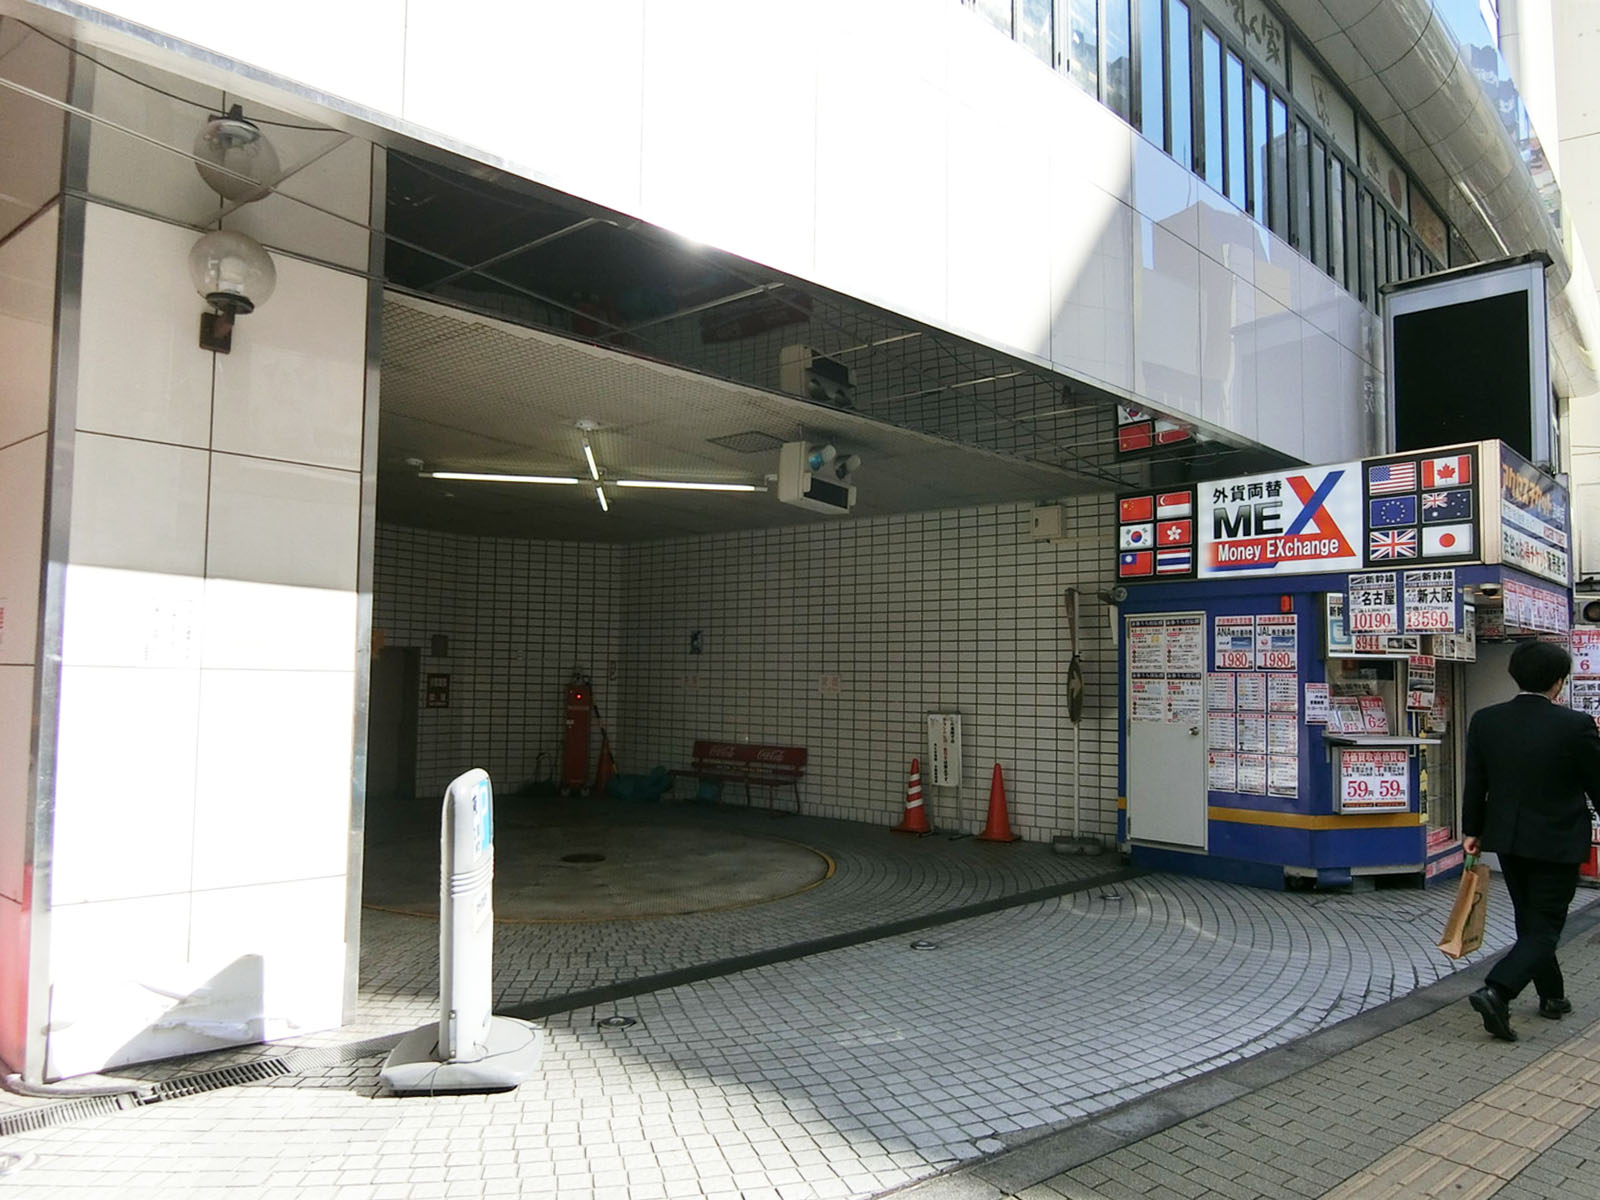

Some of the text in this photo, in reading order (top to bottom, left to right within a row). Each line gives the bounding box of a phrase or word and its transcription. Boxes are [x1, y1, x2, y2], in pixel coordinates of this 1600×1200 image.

[1212, 480, 1282, 504] 外貨両替
[1213, 469, 1347, 540] MEX
[1218, 538, 1339, 562] Money EXchange
[1422, 571, 1453, 581] 新幹線
[1362, 590, 1395, 606] 名古屋
[1417, 587, 1453, 604] 新大阪
